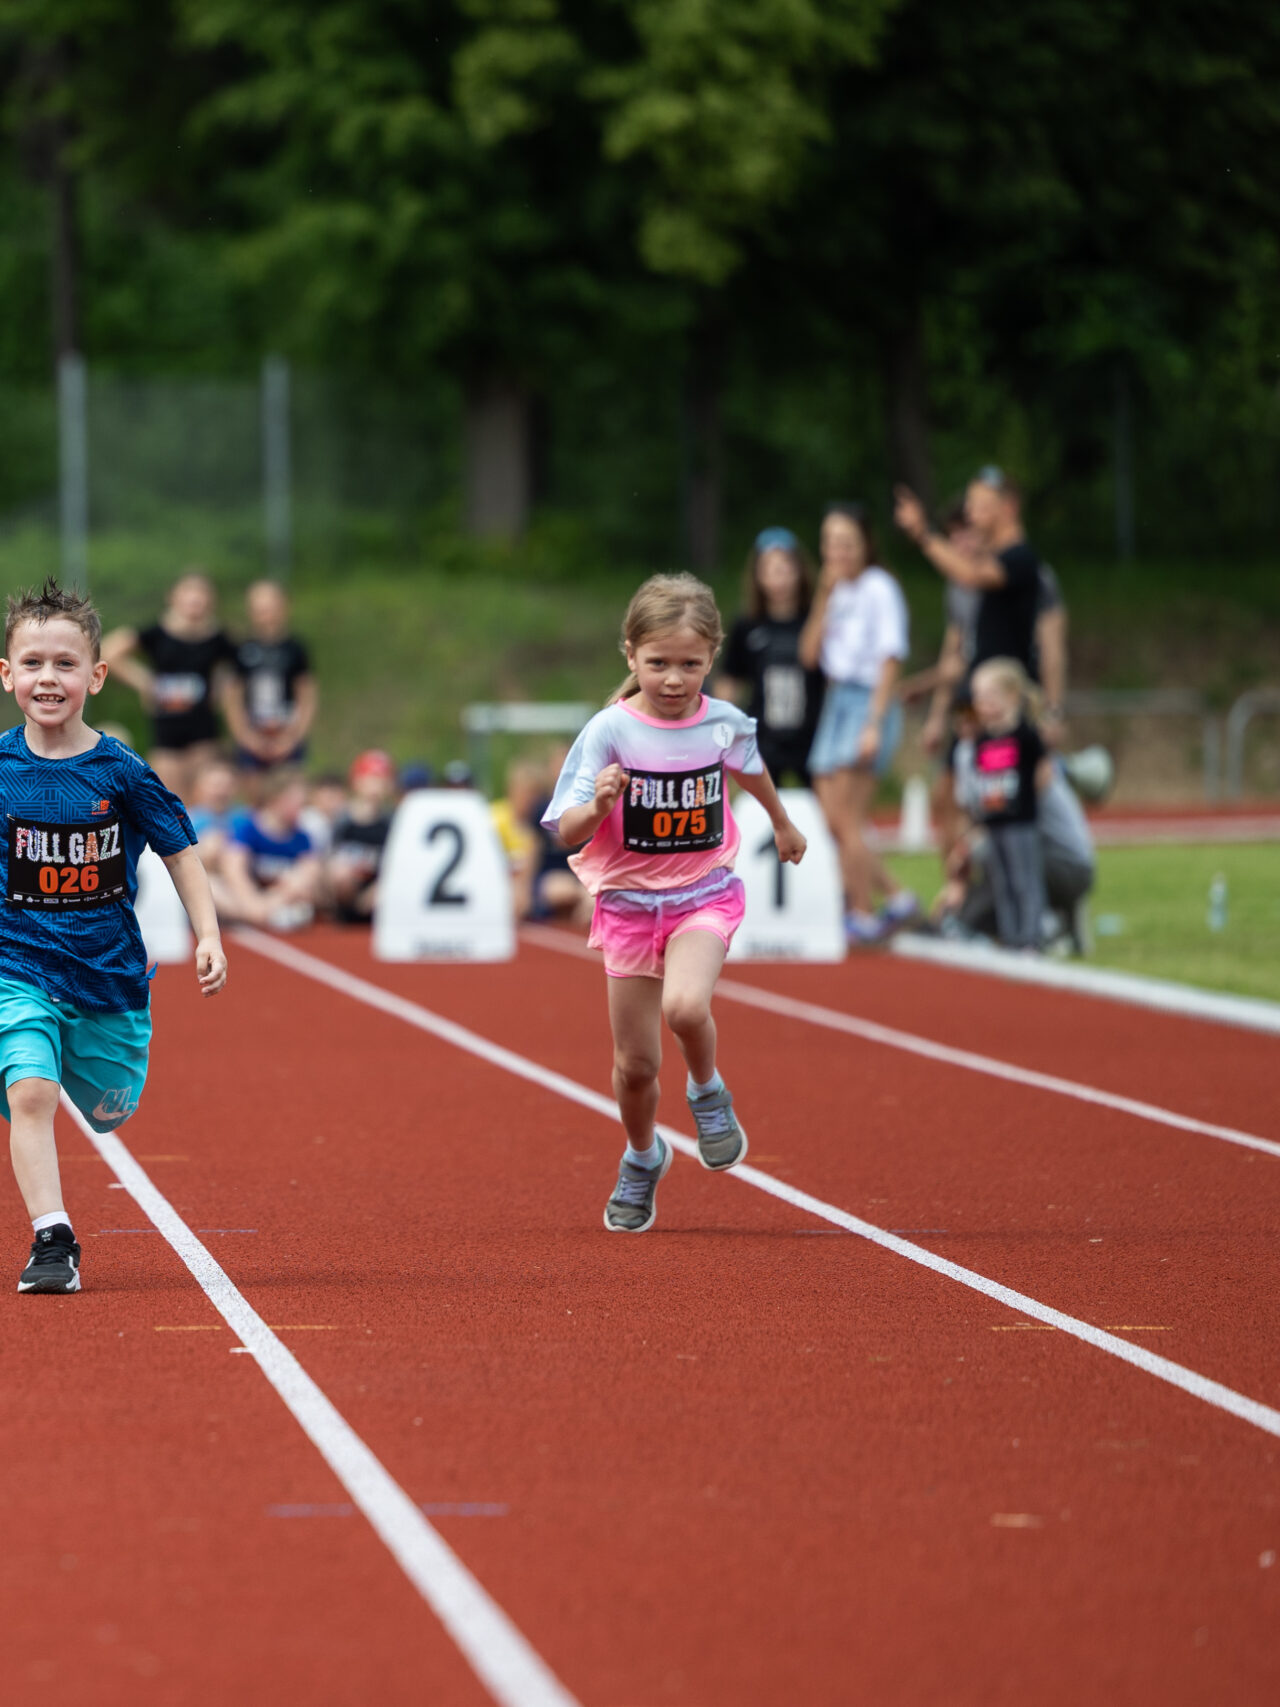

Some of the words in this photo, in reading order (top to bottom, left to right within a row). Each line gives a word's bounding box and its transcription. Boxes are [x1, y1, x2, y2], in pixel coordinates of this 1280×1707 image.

[630, 776, 679, 809] FULL
[681, 770, 722, 809] GAZZ
[653, 809, 706, 838] 075
[15, 826, 66, 863] FULL
[69, 822, 121, 865] GAZZ
[39, 865, 99, 894] 026
[427, 822, 467, 907] 2
